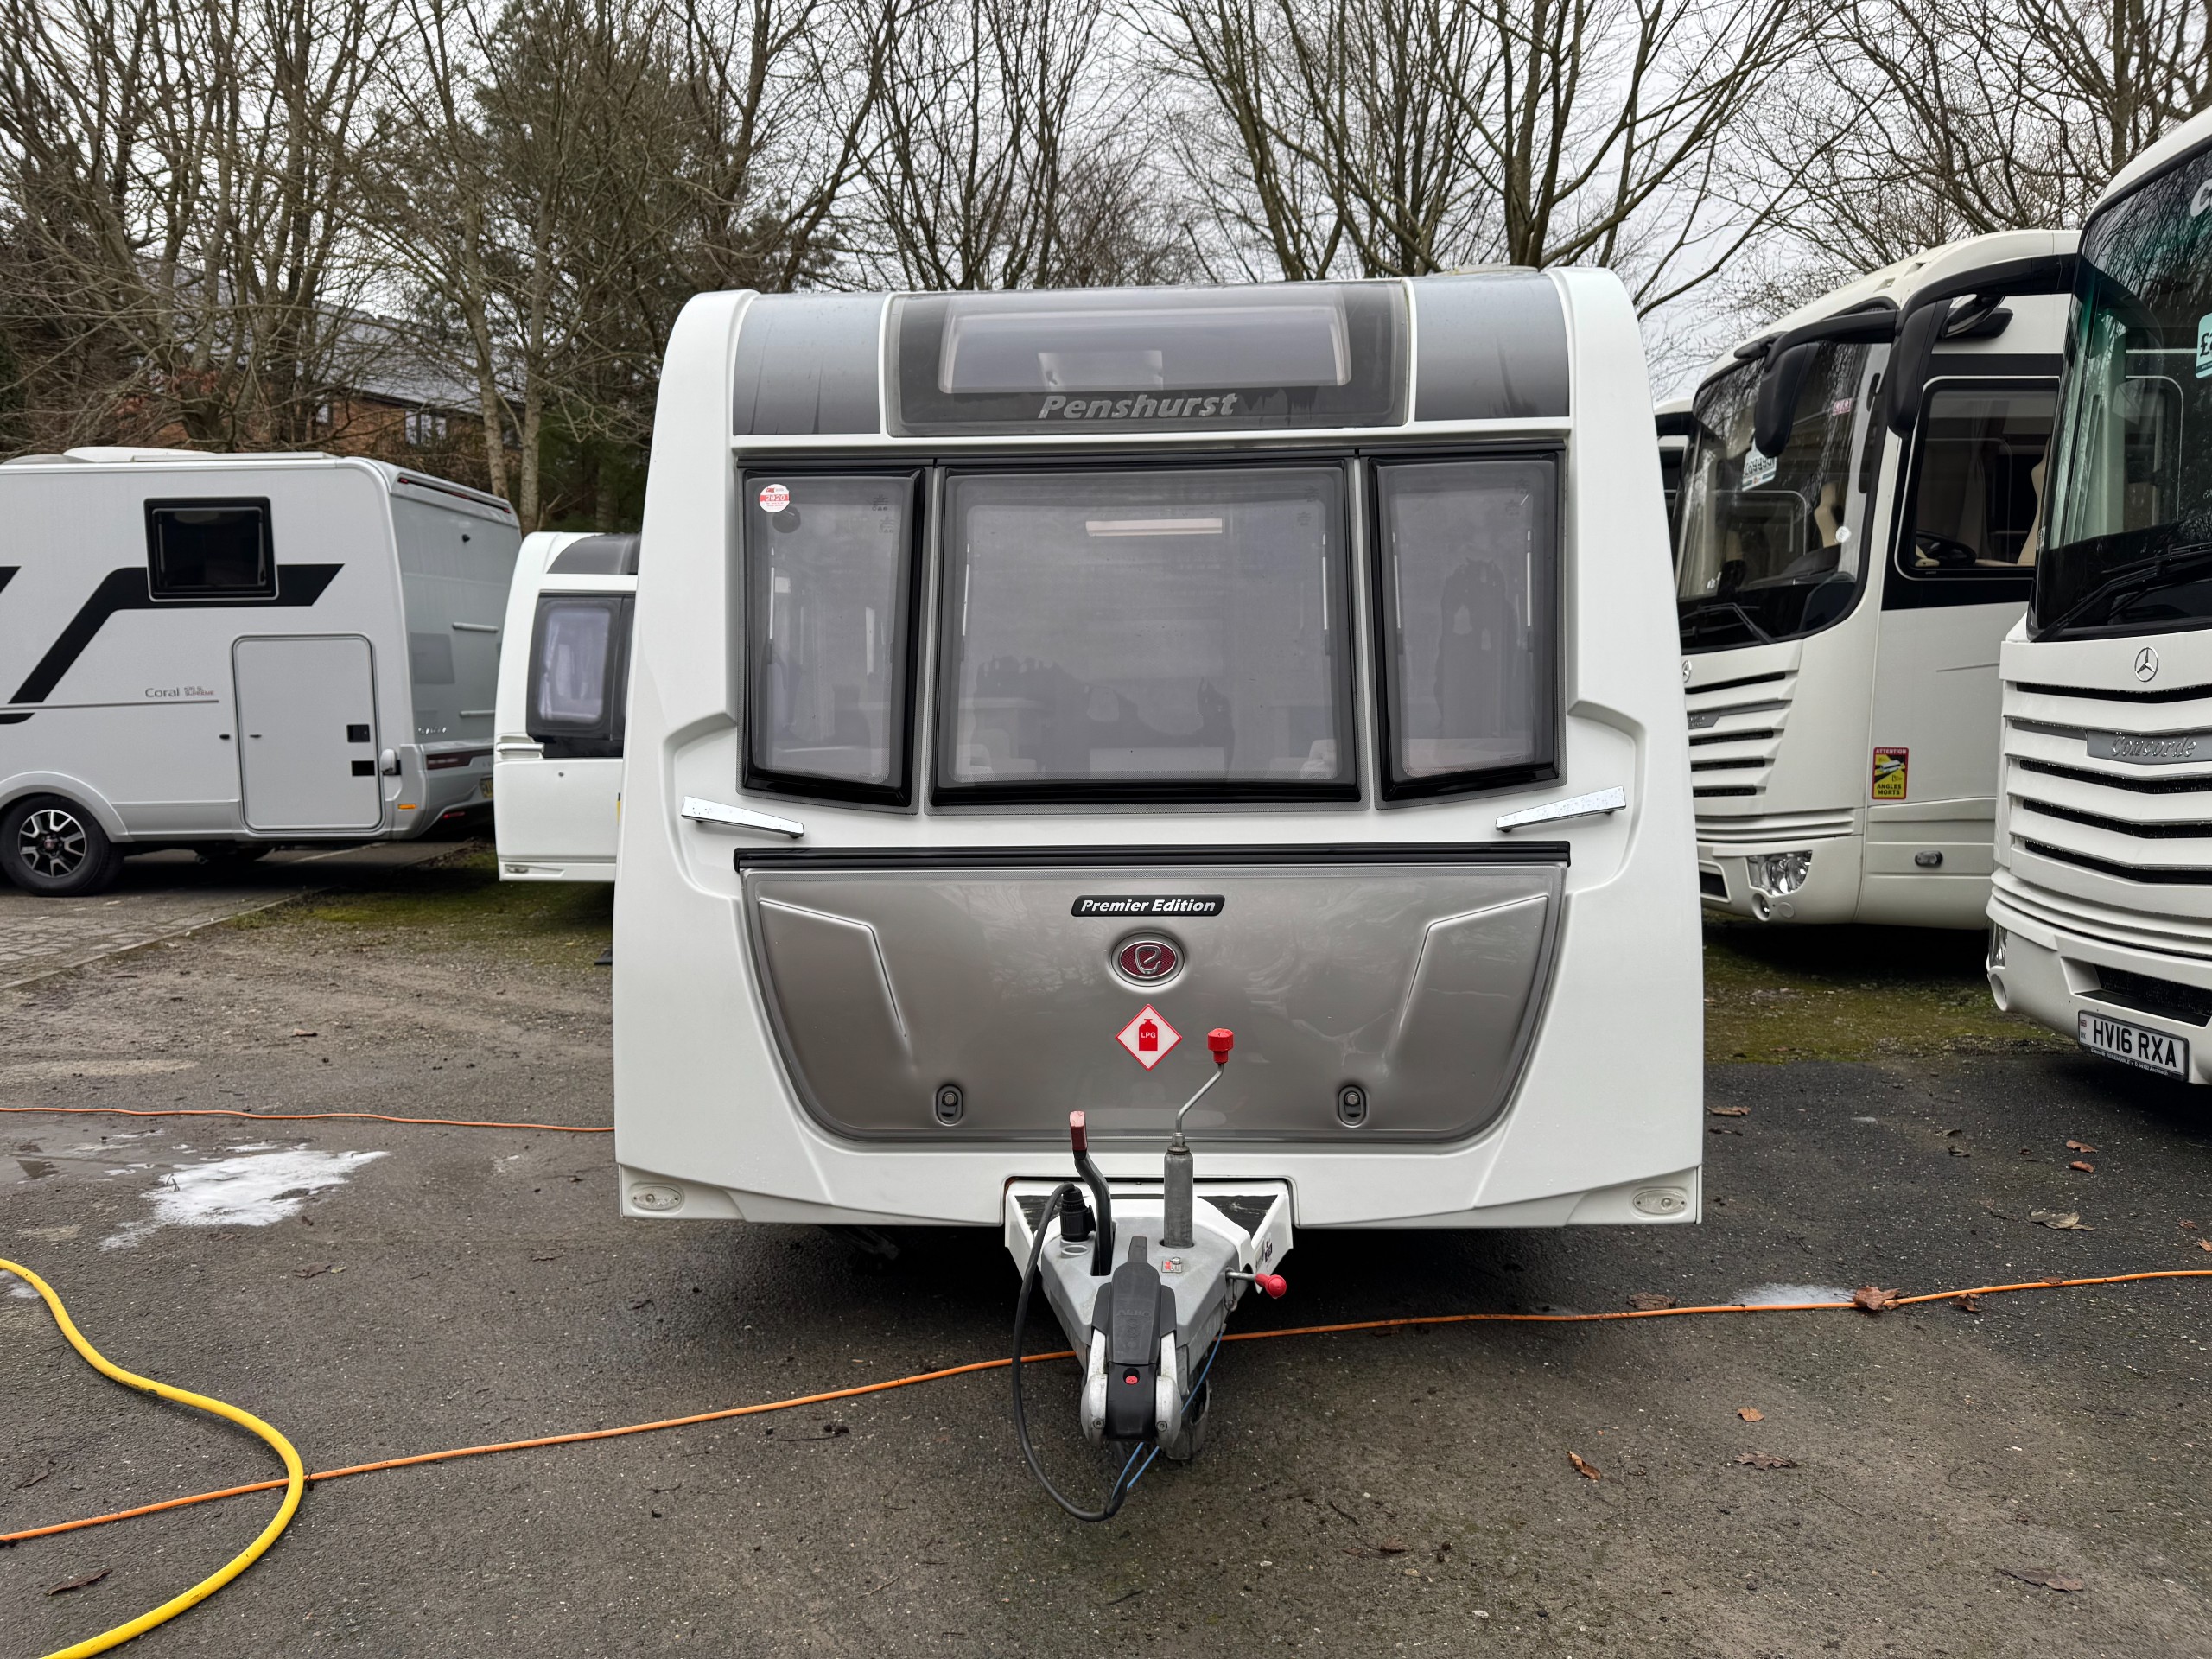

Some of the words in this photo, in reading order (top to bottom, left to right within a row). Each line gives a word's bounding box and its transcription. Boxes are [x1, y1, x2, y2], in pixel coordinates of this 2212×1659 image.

[1038, 393, 1238, 418] Penshurst
[145, 687, 180, 698] Coral
[2111, 735, 2196, 758] Concorde
[1081, 899, 1149, 912] Premier
[1152, 899, 1216, 912] Edition
[2093, 1019, 2133, 1054] HV16
[2138, 1032, 2177, 1068] RXA
